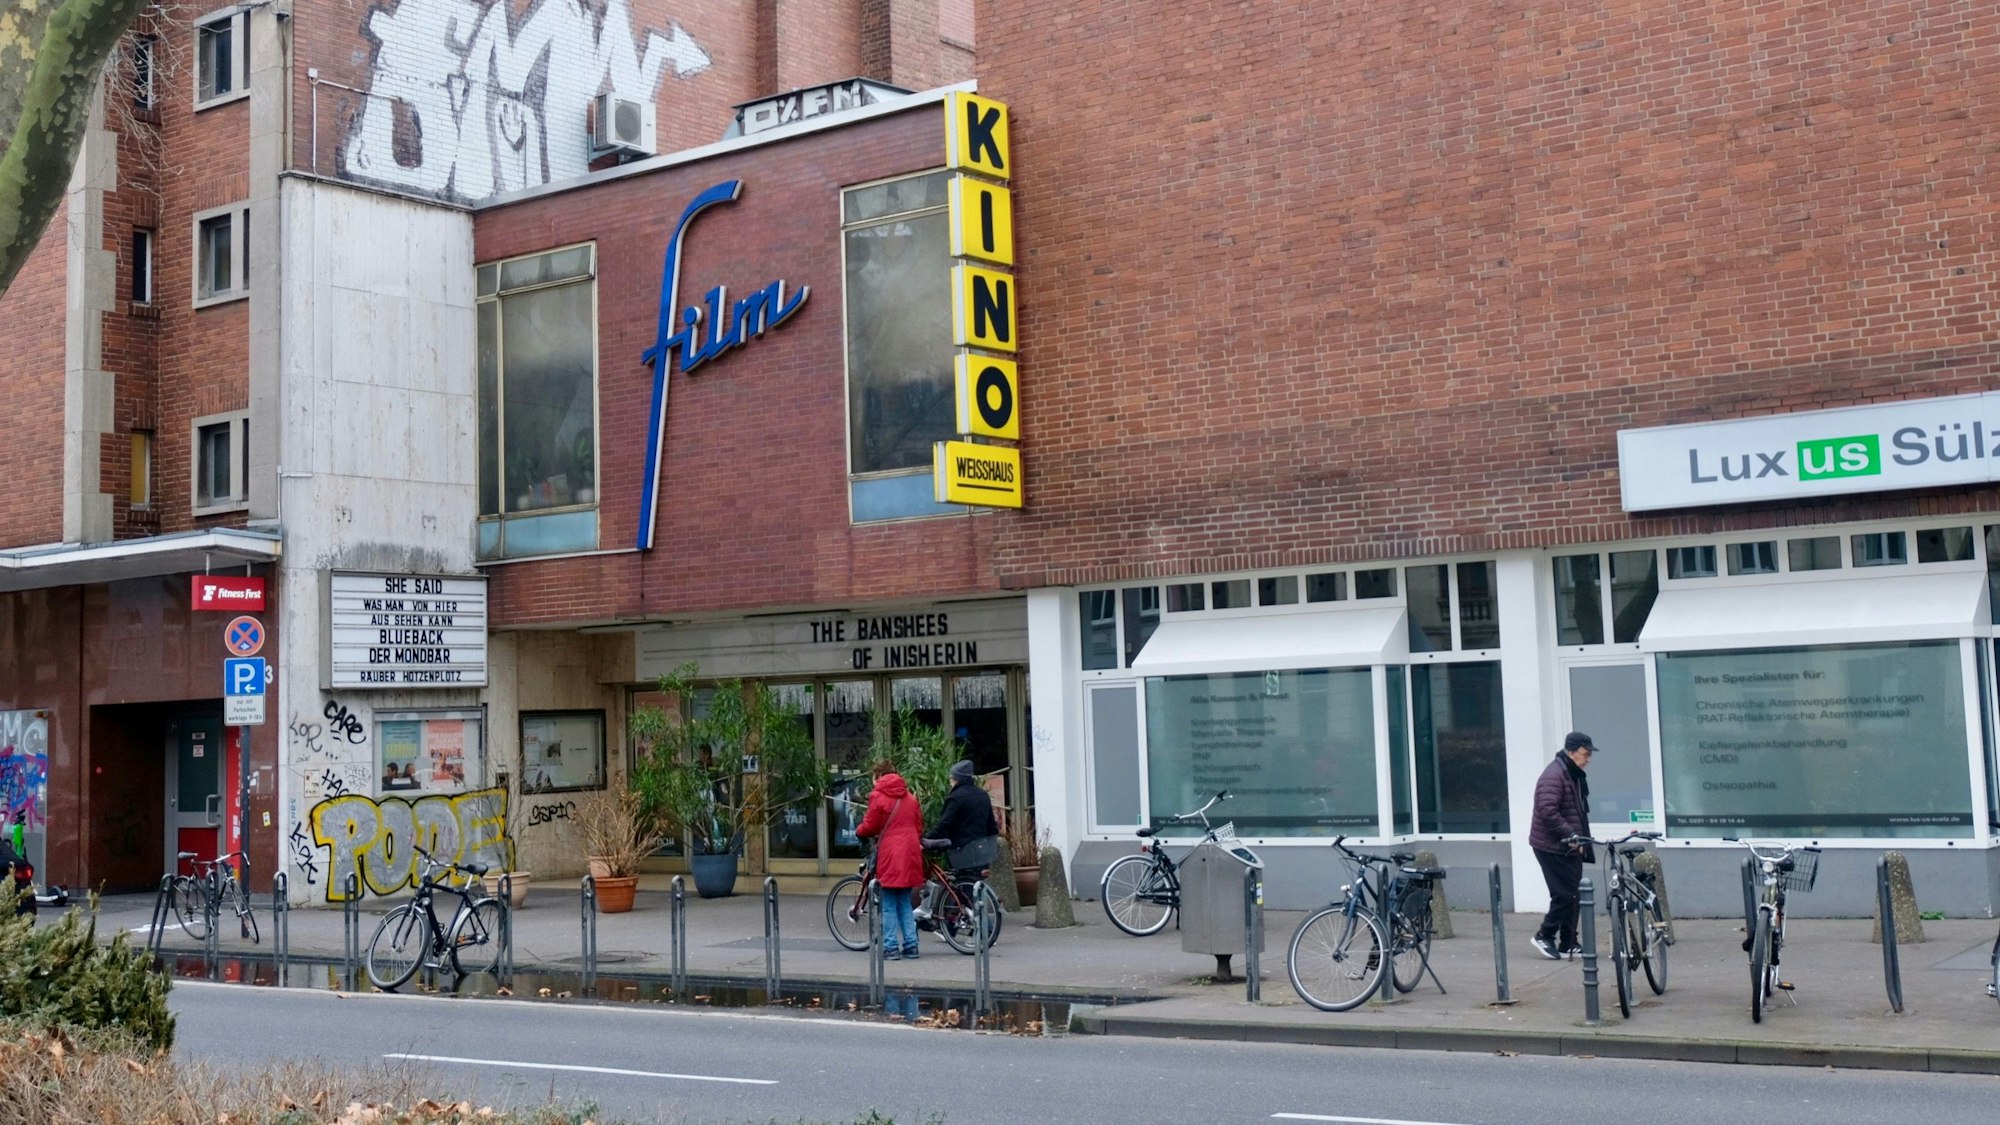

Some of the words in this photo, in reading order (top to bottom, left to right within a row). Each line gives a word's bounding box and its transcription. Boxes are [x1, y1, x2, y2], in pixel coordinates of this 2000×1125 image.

[966, 100, 1013, 429] KINO
[636, 179, 811, 549] film
[956, 456, 1014, 483] WEISSHAUS
[218, 588, 245, 599] Fitness
[245, 588, 261, 599] First
[385, 578, 407, 593] SHE
[415, 579, 442, 594] SAID
[364, 599, 382, 610] WAS
[385, 600, 404, 611] MAN
[413, 601, 428, 612] VON
[435, 601, 457, 612] HIER
[371, 615, 389, 625] AUS
[394, 615, 423, 626] SEHEN
[429, 616, 453, 626] KANN
[810, 620, 845, 643] THE
[858, 613, 947, 641] BANSHEES
[380, 629, 444, 645] BLUEBACK
[369, 648, 390, 663] DER
[853, 647, 872, 669] OF
[884, 641, 977, 668] INISHERIN
[234, 664, 255, 693] P
[403, 670, 461, 682] HOTZENPLOTZ
[1694, 674, 1719, 684] Ihre
[1722, 671, 1799, 684] Spezialisten
[1803, 670, 1825, 680] für:
[1696, 699, 1764, 711] Chronische
[1768, 693, 1924, 709] Atemwegserkrankungen
[1702, 780, 1778, 791] Osteopathie
